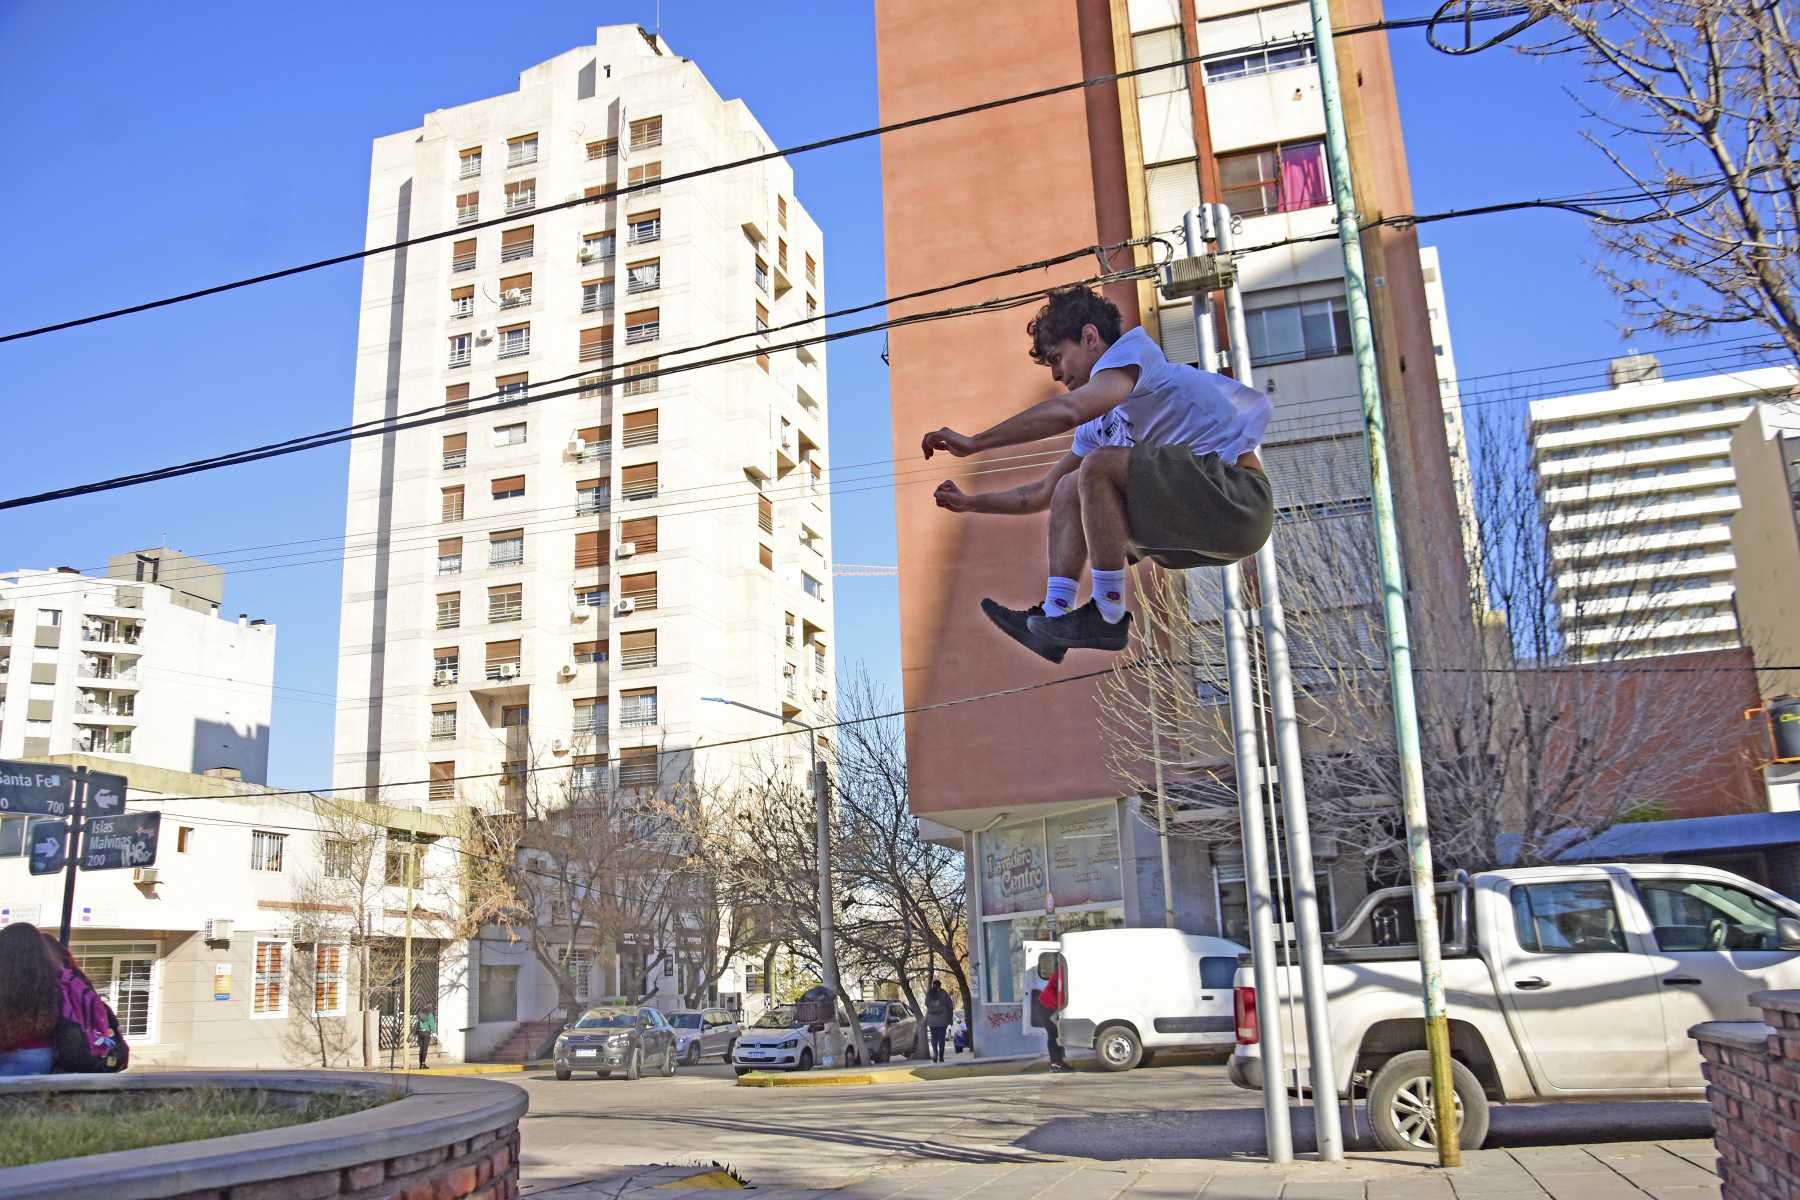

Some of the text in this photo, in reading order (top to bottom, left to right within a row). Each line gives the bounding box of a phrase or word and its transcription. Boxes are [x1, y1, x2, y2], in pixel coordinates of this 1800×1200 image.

[35, 774, 53, 788] Fe
[46, 800, 64, 814] 700
[92, 820, 114, 834] Islas
[89, 834, 132, 850] Malvinas
[87, 854, 106, 867] 200
[1001, 867, 1042, 897] Centro
